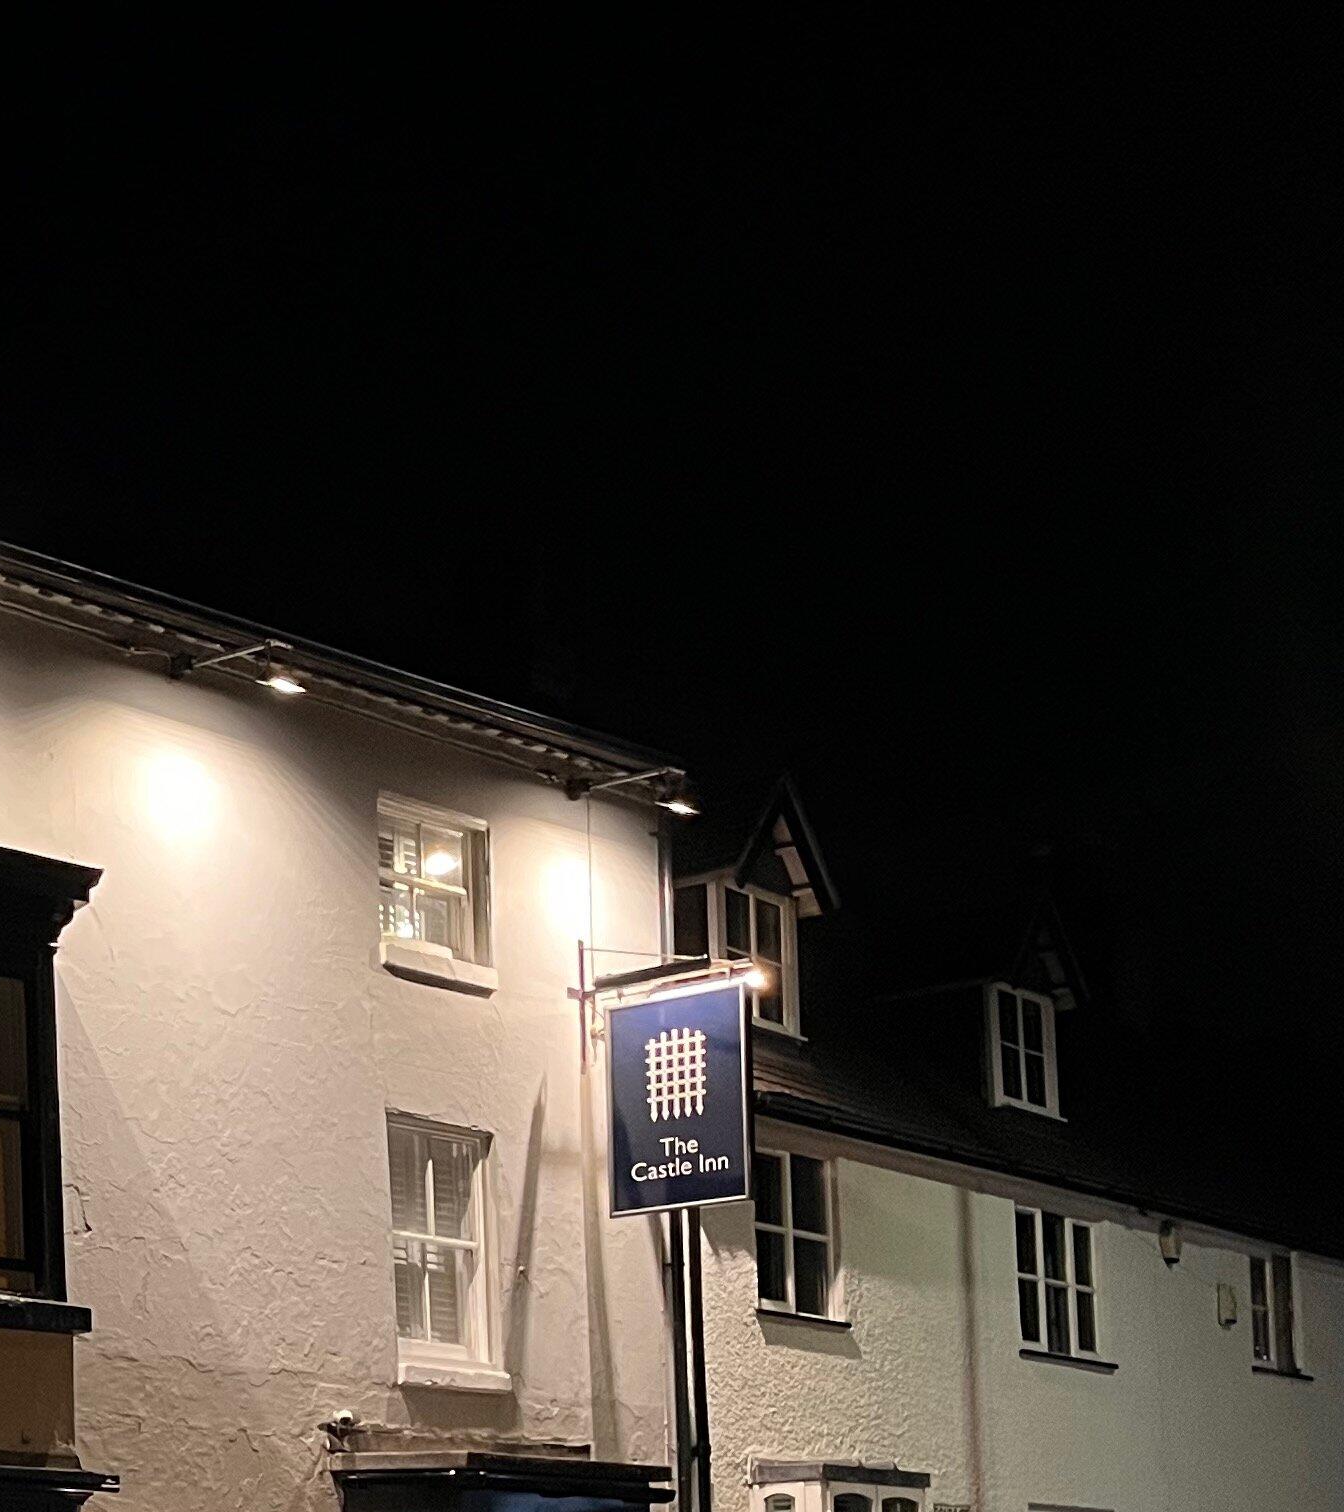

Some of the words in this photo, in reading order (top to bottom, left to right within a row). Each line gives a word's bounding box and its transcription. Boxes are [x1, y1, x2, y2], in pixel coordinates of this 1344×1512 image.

[659, 1136, 699, 1157] The
[630, 1157, 693, 1182] Castle
[698, 1153, 730, 1173] Inn
